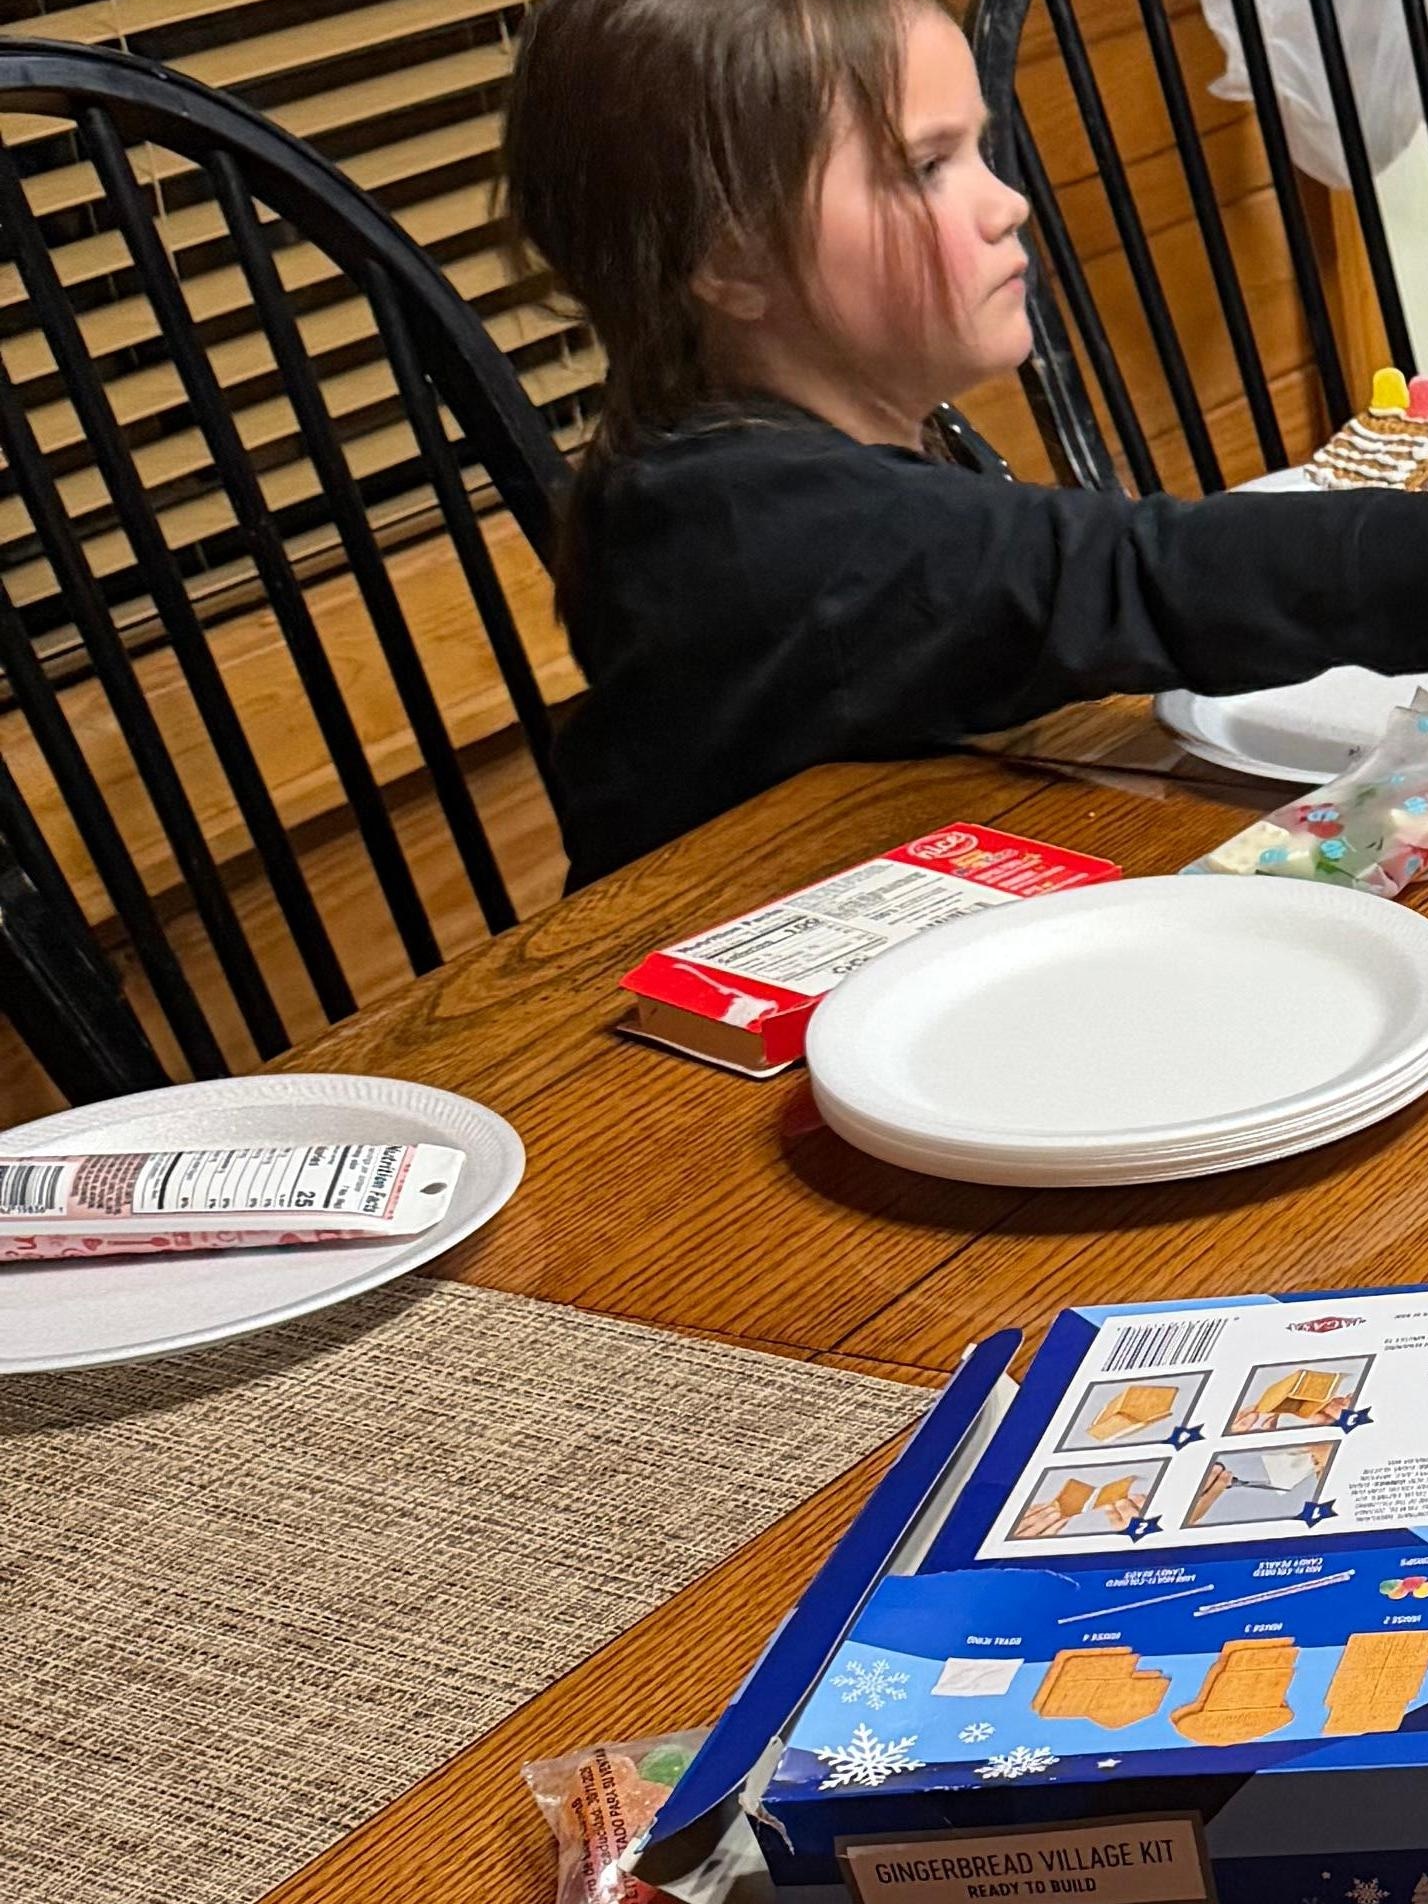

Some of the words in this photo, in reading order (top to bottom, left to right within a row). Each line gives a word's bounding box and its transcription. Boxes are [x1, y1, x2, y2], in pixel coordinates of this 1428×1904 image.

[294, 1190, 317, 1209] 25
[875, 1851, 1034, 1885] GINGERBREAD
[1039, 1842, 1135, 1873] VILLAGE
[1140, 1839, 1175, 1865] KIT
[967, 1882, 1020, 1900] READY
[1024, 1880, 1047, 1896] TO
[1050, 1877, 1097, 1894] BUILD
